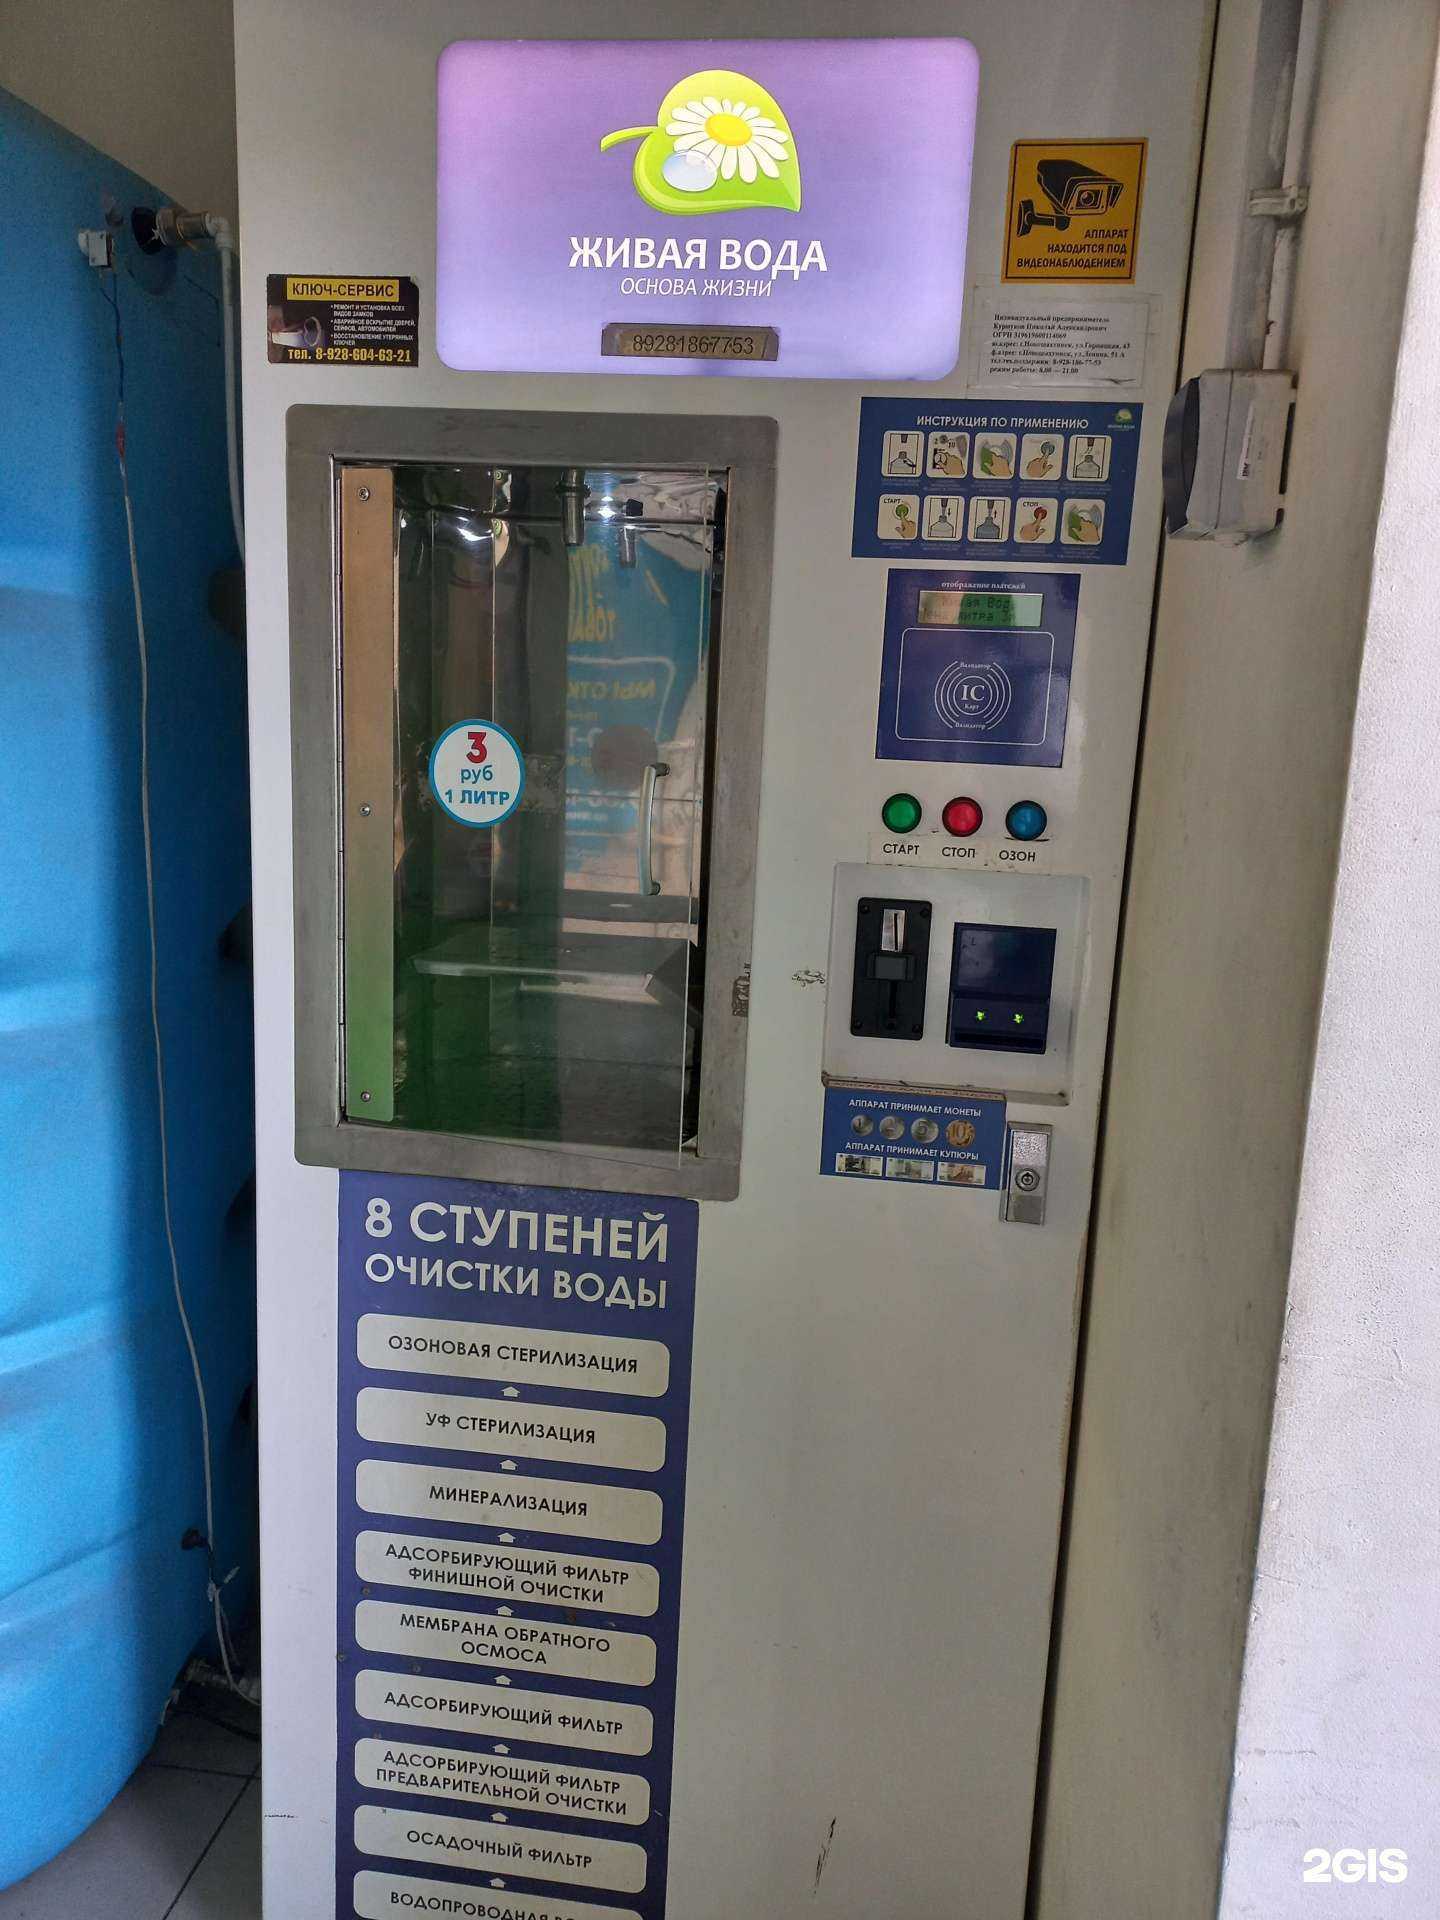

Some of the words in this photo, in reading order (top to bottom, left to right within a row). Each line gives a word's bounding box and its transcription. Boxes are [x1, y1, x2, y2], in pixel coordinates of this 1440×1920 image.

[1085, 229, 1128, 238] АППАРАТ
[568, 236, 707, 269] ЖИВАЯ
[719, 239, 828, 280] ВОДА
[1048, 243, 1103, 254] НАХОДИТСЯ
[1107, 244, 1127, 255] ПОД
[1017, 258, 1125, 269] ВИДЕОНАБЛЮДЕНИЕМ
[292, 283, 394, 297] КЛЮЧ-СЕРВИС
[620, 277, 697, 296] ОСНОВА
[702, 279, 771, 297] ЖИЗНИ
[288, 349, 311, 360] тел.
[315, 348, 411, 362] 8-928-604-63-21
[917, 415, 987, 428] ИНСТРУКЦИЯ
[990, 416, 1007, 428] ПО
[1010, 417, 1089, 429] ПРИМЕНЕНИЮ
[960, 684, 985, 701] IC
[466, 731, 488, 764] 3
[460, 764, 493, 784] руб
[444, 789, 453, 803] 1
[460, 789, 510, 805] ЛИТР
[882, 843, 920, 855] СТАРТ
[941, 846, 976, 858] СТОП
[999, 849, 1036, 862] ОЗОН
[848, 1099, 889, 1109] АППАРАТ
[890, 1102, 942, 1114] ПРИНИМАЕТ
[943, 1106, 982, 1117] МОНЕТЫ
[845, 1141, 885, 1152] АППАРАТ
[886, 1145, 938, 1157] ПРИНИМАЕТ
[939, 1150, 979, 1160] КУПЮРЫ
[364, 1197, 393, 1238] 8
[409, 1201, 669, 1263] СТУПЕНЕЙ
[364, 1253, 539, 1297] ОЧИСТКИ
[553, 1270, 667, 1310] ВОДЫ
[388, 1335, 491, 1358] ОЗОНОВАЯ
[496, 1345, 638, 1374] СТЕРИЛИЗАЦИЯ
[426, 1411, 451, 1428] УФ
[456, 1415, 596, 1444] СТЕРИЛИЗАЦИЯ
[428, 1485, 588, 1517] МИНЕРАЛИЗАЦИЯ
[385, 1543, 557, 1577] АДСОРБИРУЮЩИЙ
[562, 1564, 629, 1586] ФИЛЬТР
[408, 1566, 515, 1592] ФИНИШНОЙ
[520, 1580, 604, 1603] ОЧИСТКИ
[399, 1612, 498, 1638] МЕМБРАНА
[504, 1625, 610, 1652] ОБРАТНОГО
[461, 1640, 547, 1665] ОСМОСА
[384, 1691, 552, 1726] АДСОРБИРУЮЩИЙ
[557, 1714, 624, 1735] ФИЛЬТР
[383, 1750, 550, 1785] АДСОРБИРУЮЩИЙ
[555, 1774, 620, 1795] ФИЛЬТР
[376, 1768, 540, 1803] ПРЕДВАРИТЕЛЬНОЙ
[545, 1792, 627, 1815] ОЧИСТКИ
[406, 1829, 523, 1859] ОСАДОЧНЫЙ
[528, 1848, 592, 1869] ФИЛЬТР
